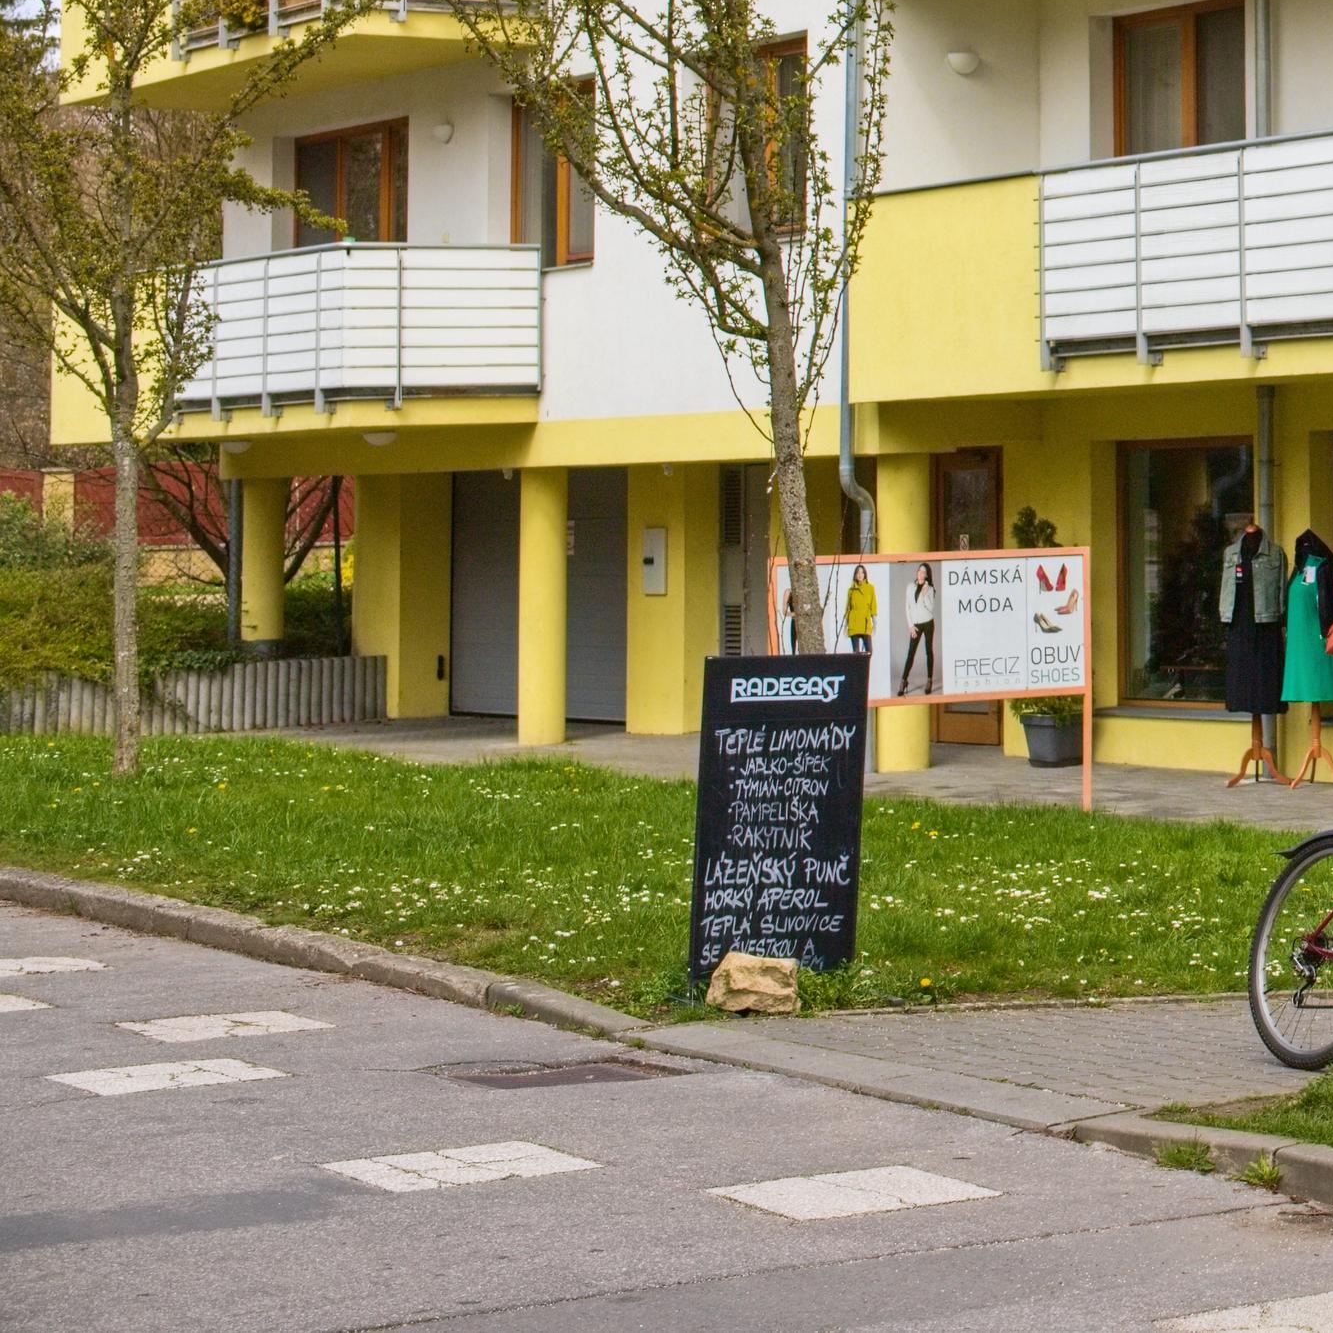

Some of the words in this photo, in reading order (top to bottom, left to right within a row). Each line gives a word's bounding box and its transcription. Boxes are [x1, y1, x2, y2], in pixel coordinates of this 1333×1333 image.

[948, 565, 1023, 586] DÁMSKÁ
[958, 595, 1014, 614] MÓDA
[954, 656, 1020, 677] PRECIZ
[1031, 645, 1081, 665] OBUV
[730, 674, 846, 703] RADEGAST
[1031, 667, 1080, 684] SHOES
[769, 722, 857, 752] LIMONÁDY
[731, 796, 820, 824] PAMPELIŠKA
[732, 822, 814, 851] RAKYTNÍK
[704, 851, 798, 889] LÁZEŇSKÝ
[803, 854, 851, 886] PUNČ
[704, 883, 754, 911] HORKÝ
[757, 888, 829, 911] APEROL
[700, 912, 752, 938] TEPLÁ
[760, 913, 844, 934] SLIVOVICE
[700, 943, 722, 965] SE
[804, 938, 815, 956] A
